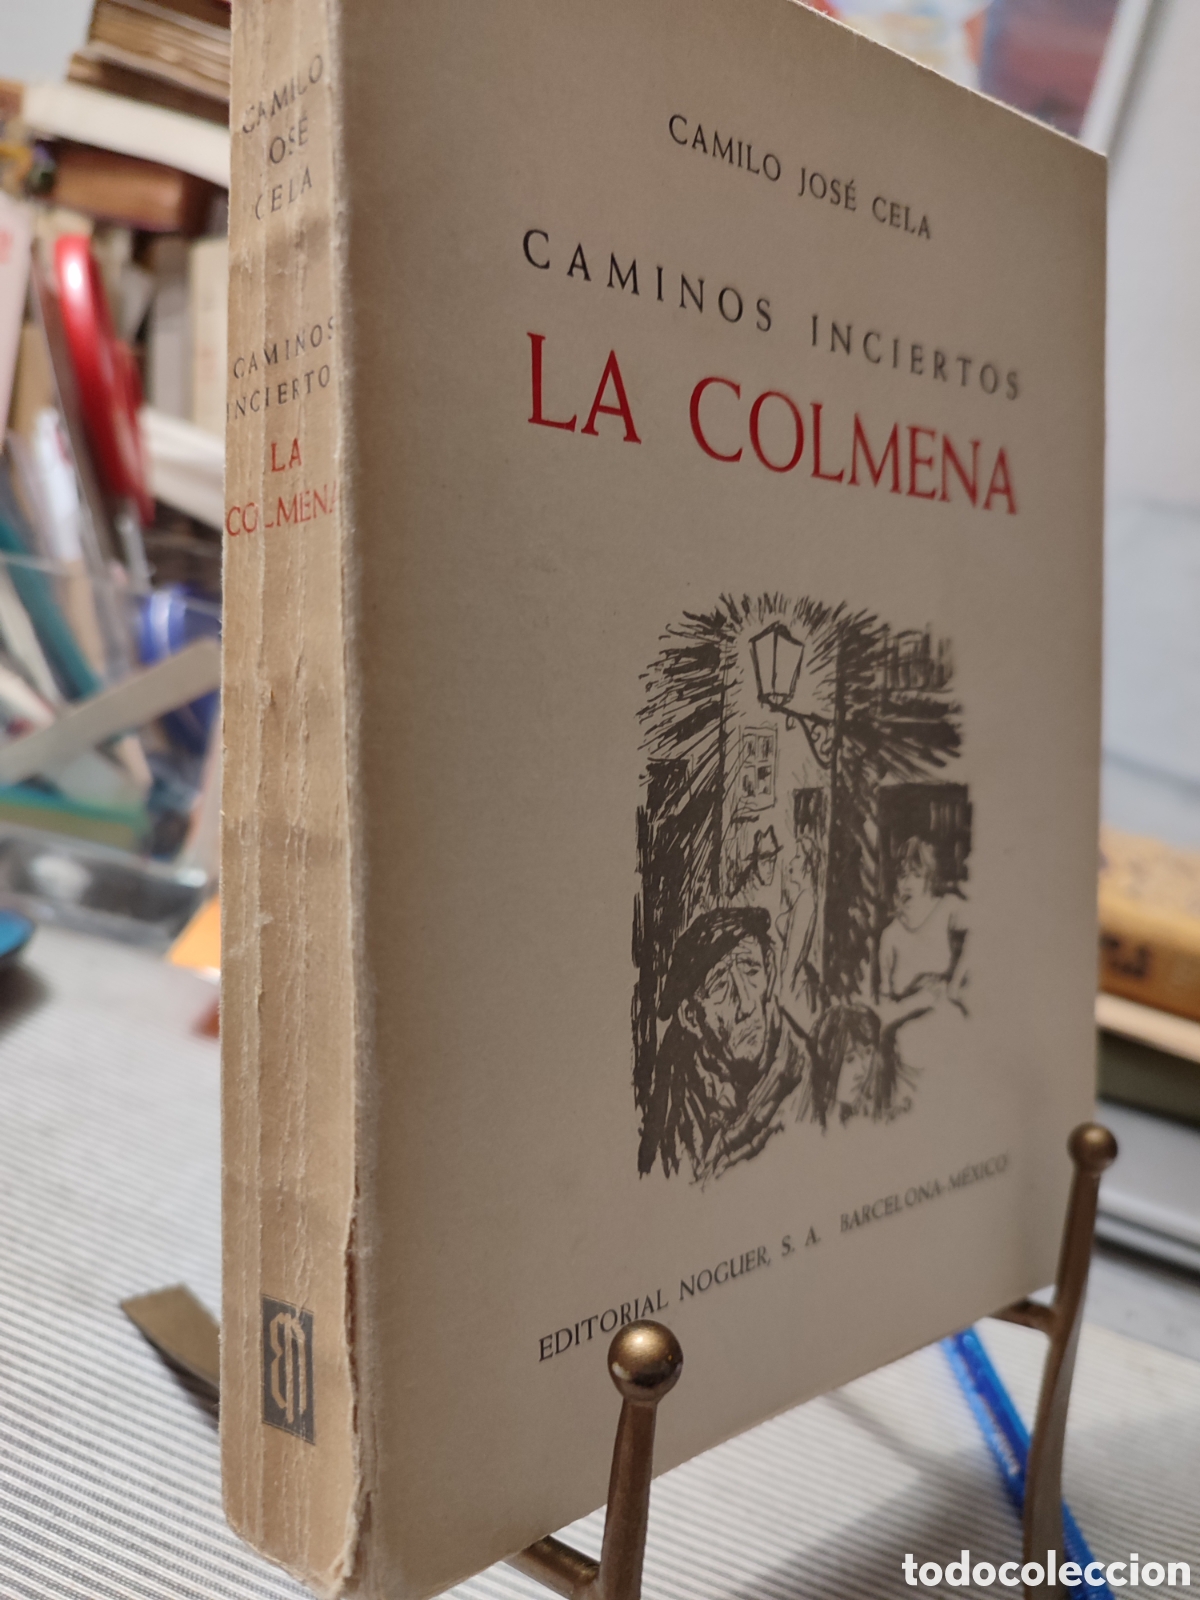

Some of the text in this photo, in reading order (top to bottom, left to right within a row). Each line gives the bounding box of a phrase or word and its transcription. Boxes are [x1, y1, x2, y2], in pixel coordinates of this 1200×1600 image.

[255, 165, 313, 221] CELA
[668, 113, 932, 241] CAMILO JOSÉ CELA
[233, 316, 334, 379] CAMINOS
[522, 229, 1021, 402] CAMINOS INCIERTOS
[226, 364, 331, 422] INCIERTO
[526, 331, 1018, 516] LA COLMENA
[270, 437, 302, 472] LA
[537, 1288, 669, 1362] EDITORIAL
[679, 1245, 772, 1301] NOGUER,
[781, 1234, 796, 1257] S.
[804, 1225, 822, 1247] A.
